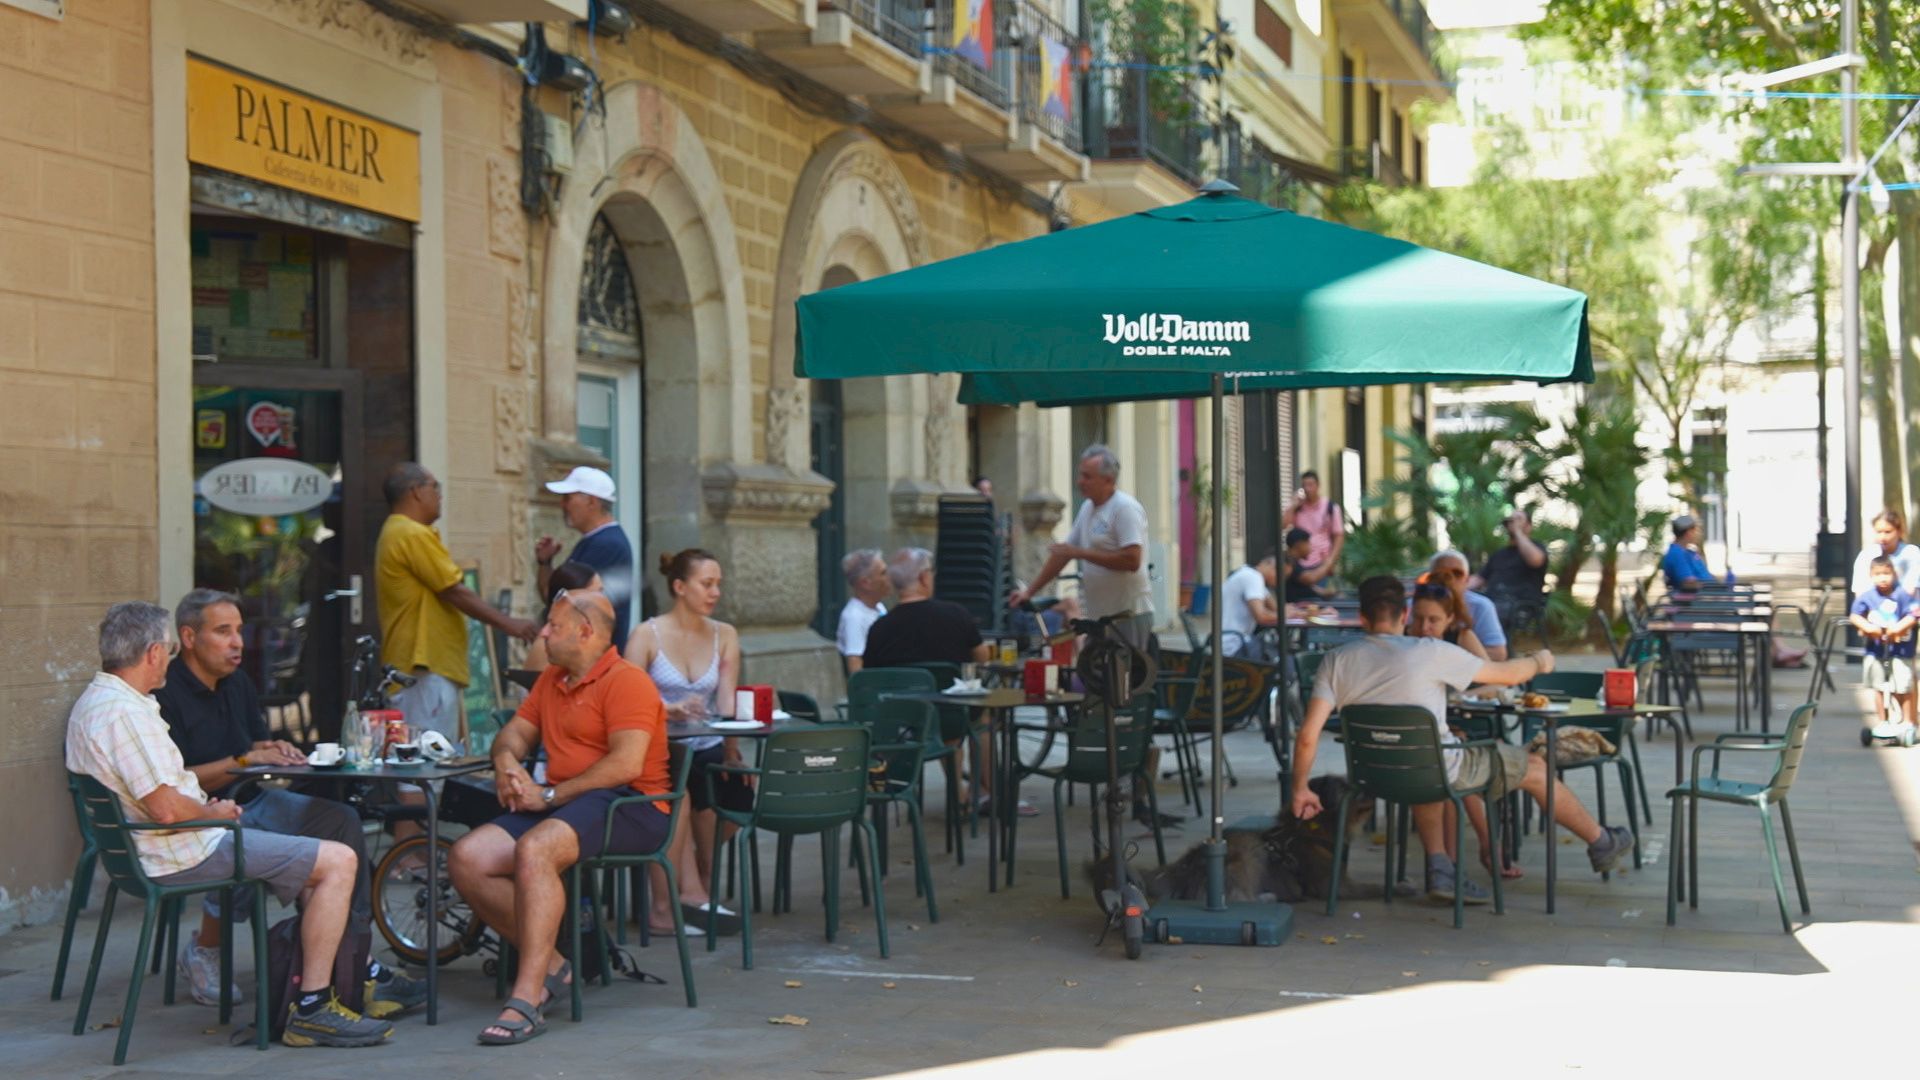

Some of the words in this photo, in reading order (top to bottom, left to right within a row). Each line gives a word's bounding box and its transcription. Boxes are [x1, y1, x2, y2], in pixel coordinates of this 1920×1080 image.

[232, 83, 384, 183] PALMER
[1102, 313, 1251, 344] Voll-Damm
[1123, 346, 1177, 356] DOBLE
[1181, 346, 1231, 357] MALTA
